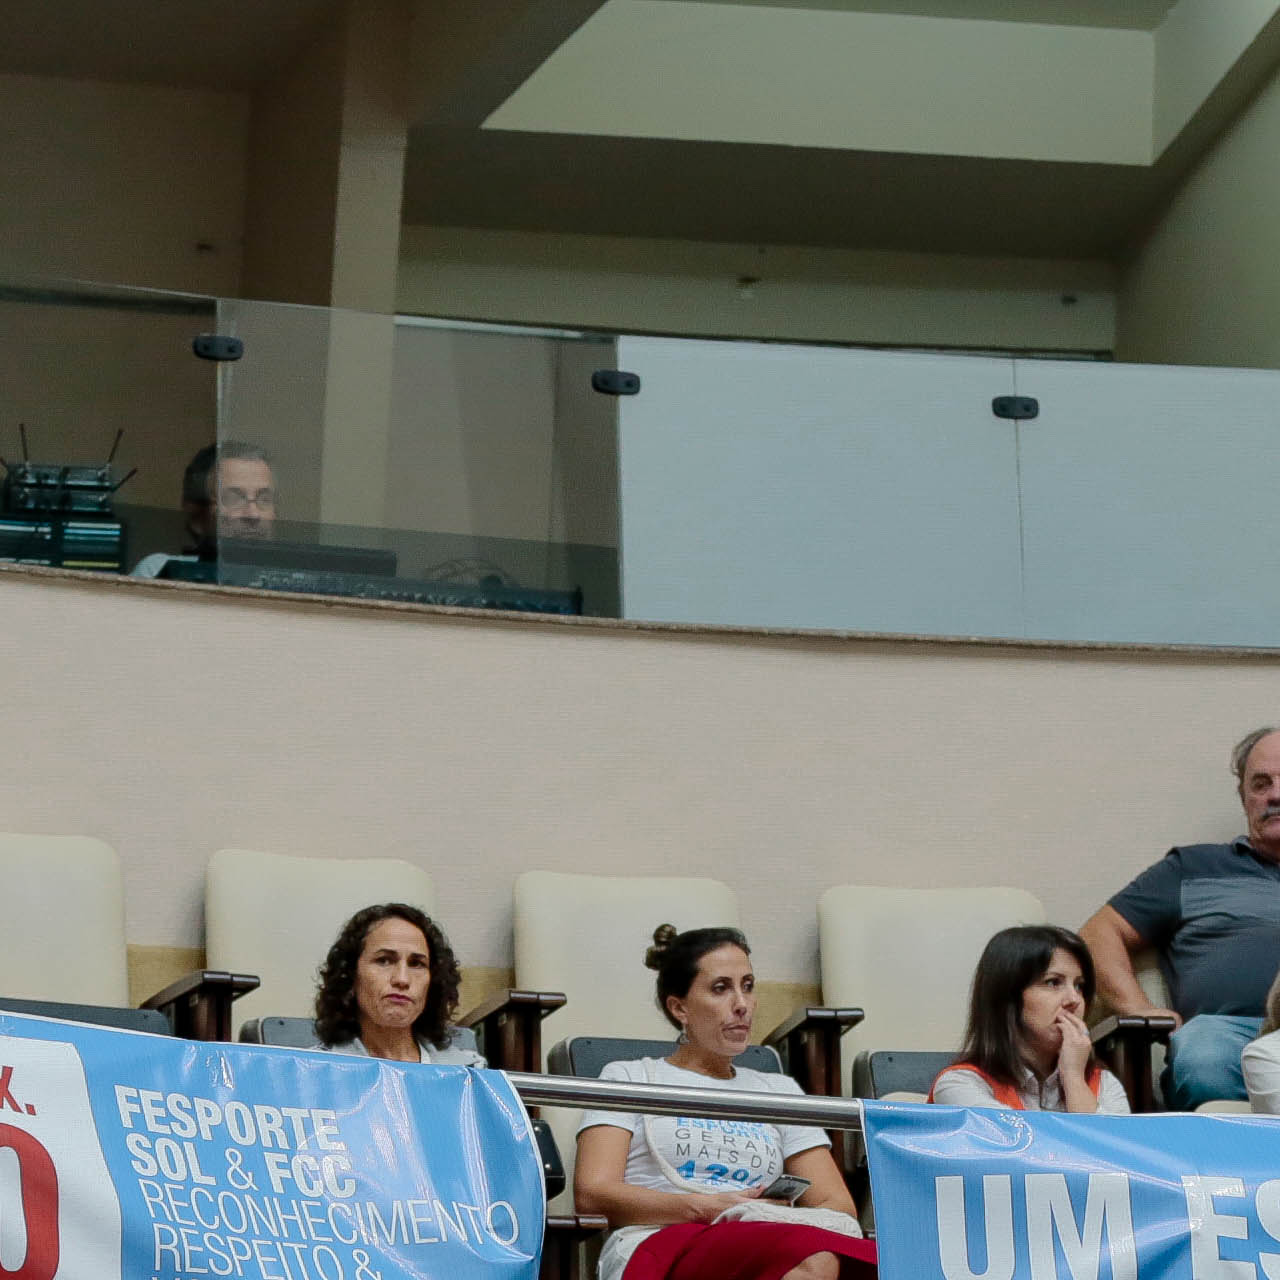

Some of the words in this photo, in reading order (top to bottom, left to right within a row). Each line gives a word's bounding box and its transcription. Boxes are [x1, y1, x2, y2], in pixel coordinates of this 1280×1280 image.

[114, 1084, 348, 1152] FESPORTE
[675, 1129, 778, 1160] GERAM
[126, 1133, 216, 1186] SOL
[225, 1148, 260, 1192] &
[263, 1152, 357, 1199] FCC
[676, 1143, 740, 1165] MAIS
[751, 1155, 777, 1177] DE
[137, 1179, 520, 1247] RECONHECIMENTO
